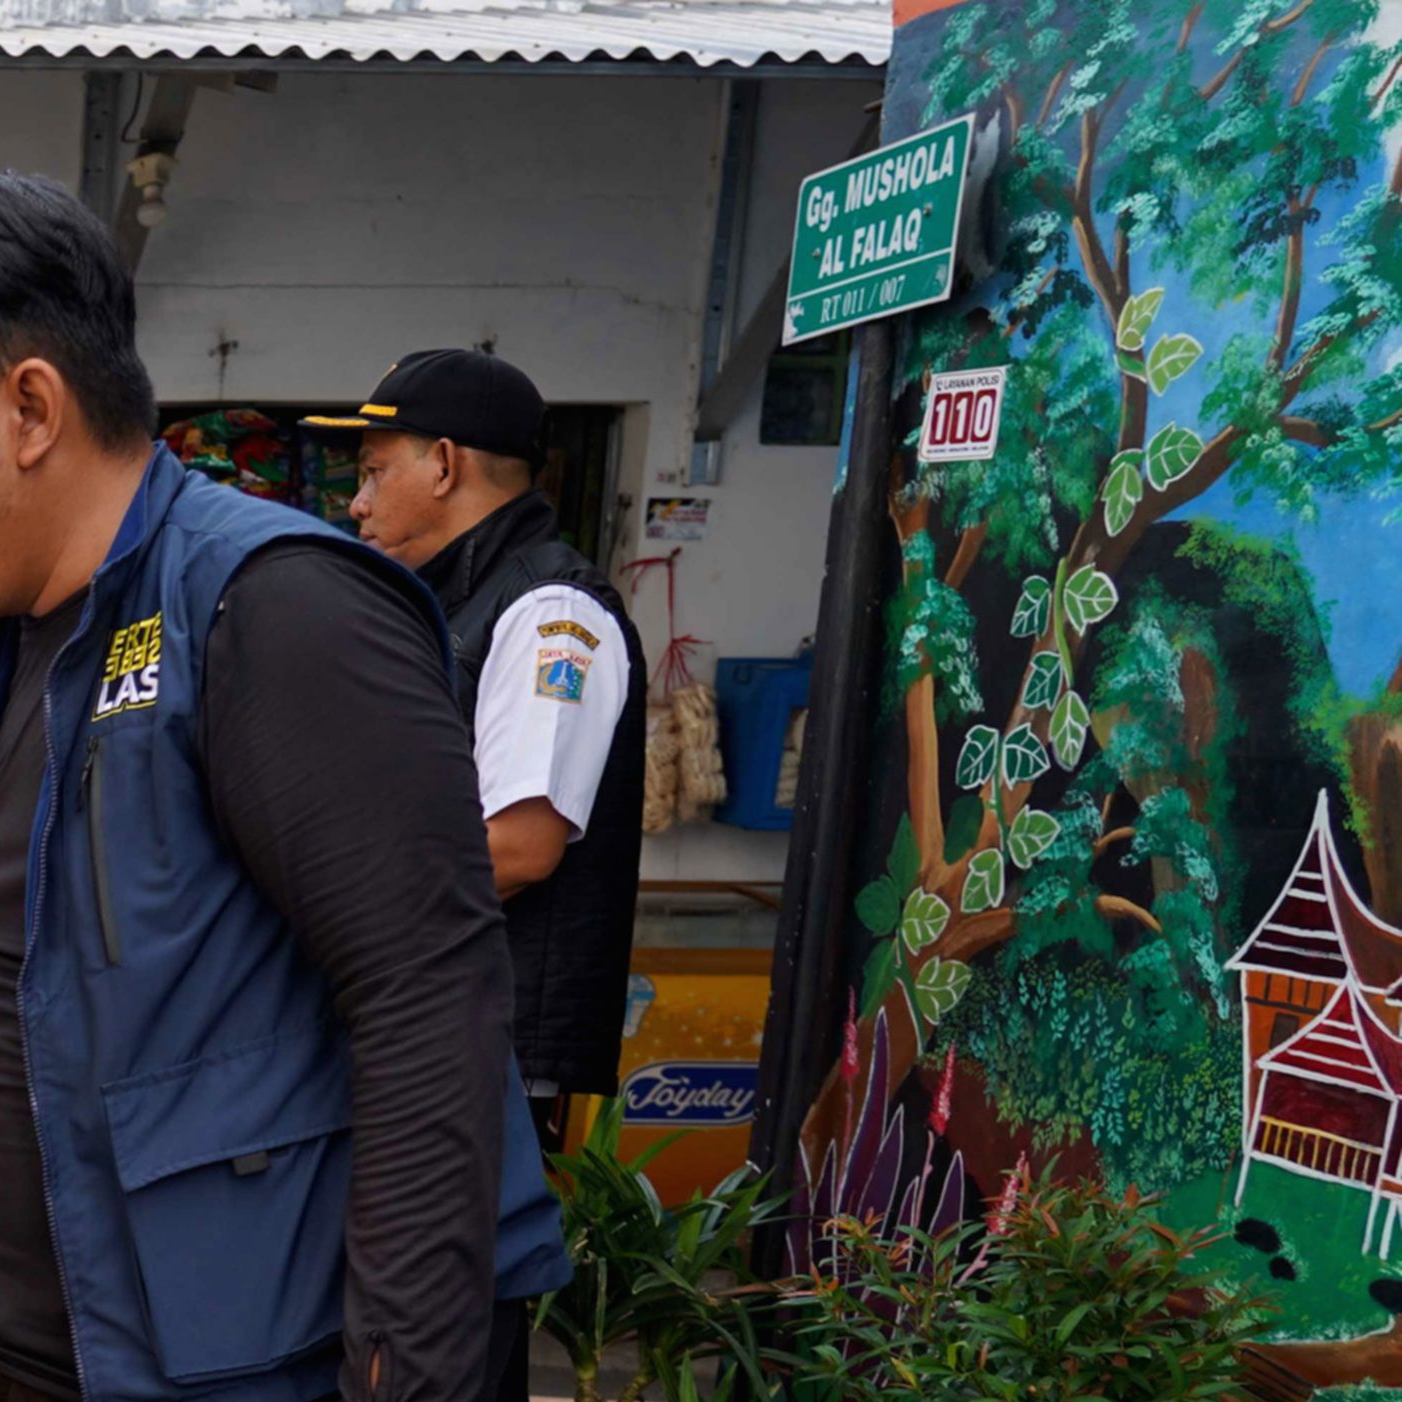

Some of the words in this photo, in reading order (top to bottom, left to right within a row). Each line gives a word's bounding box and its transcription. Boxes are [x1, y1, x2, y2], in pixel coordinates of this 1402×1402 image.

[806, 186, 839, 232] Gg.
[844, 136, 955, 213] MUSHOLA
[818, 235, 845, 279] AL
[849, 208, 922, 269] FALAQ
[820, 294, 841, 323] RT
[842, 288, 865, 317] 011
[879, 275, 906, 306] 007
[943, 379, 975, 390] LAYANAN
[977, 375, 1000, 386] POLISI
[932, 394, 994, 441] 110
[97, 663, 159, 715] LAS
